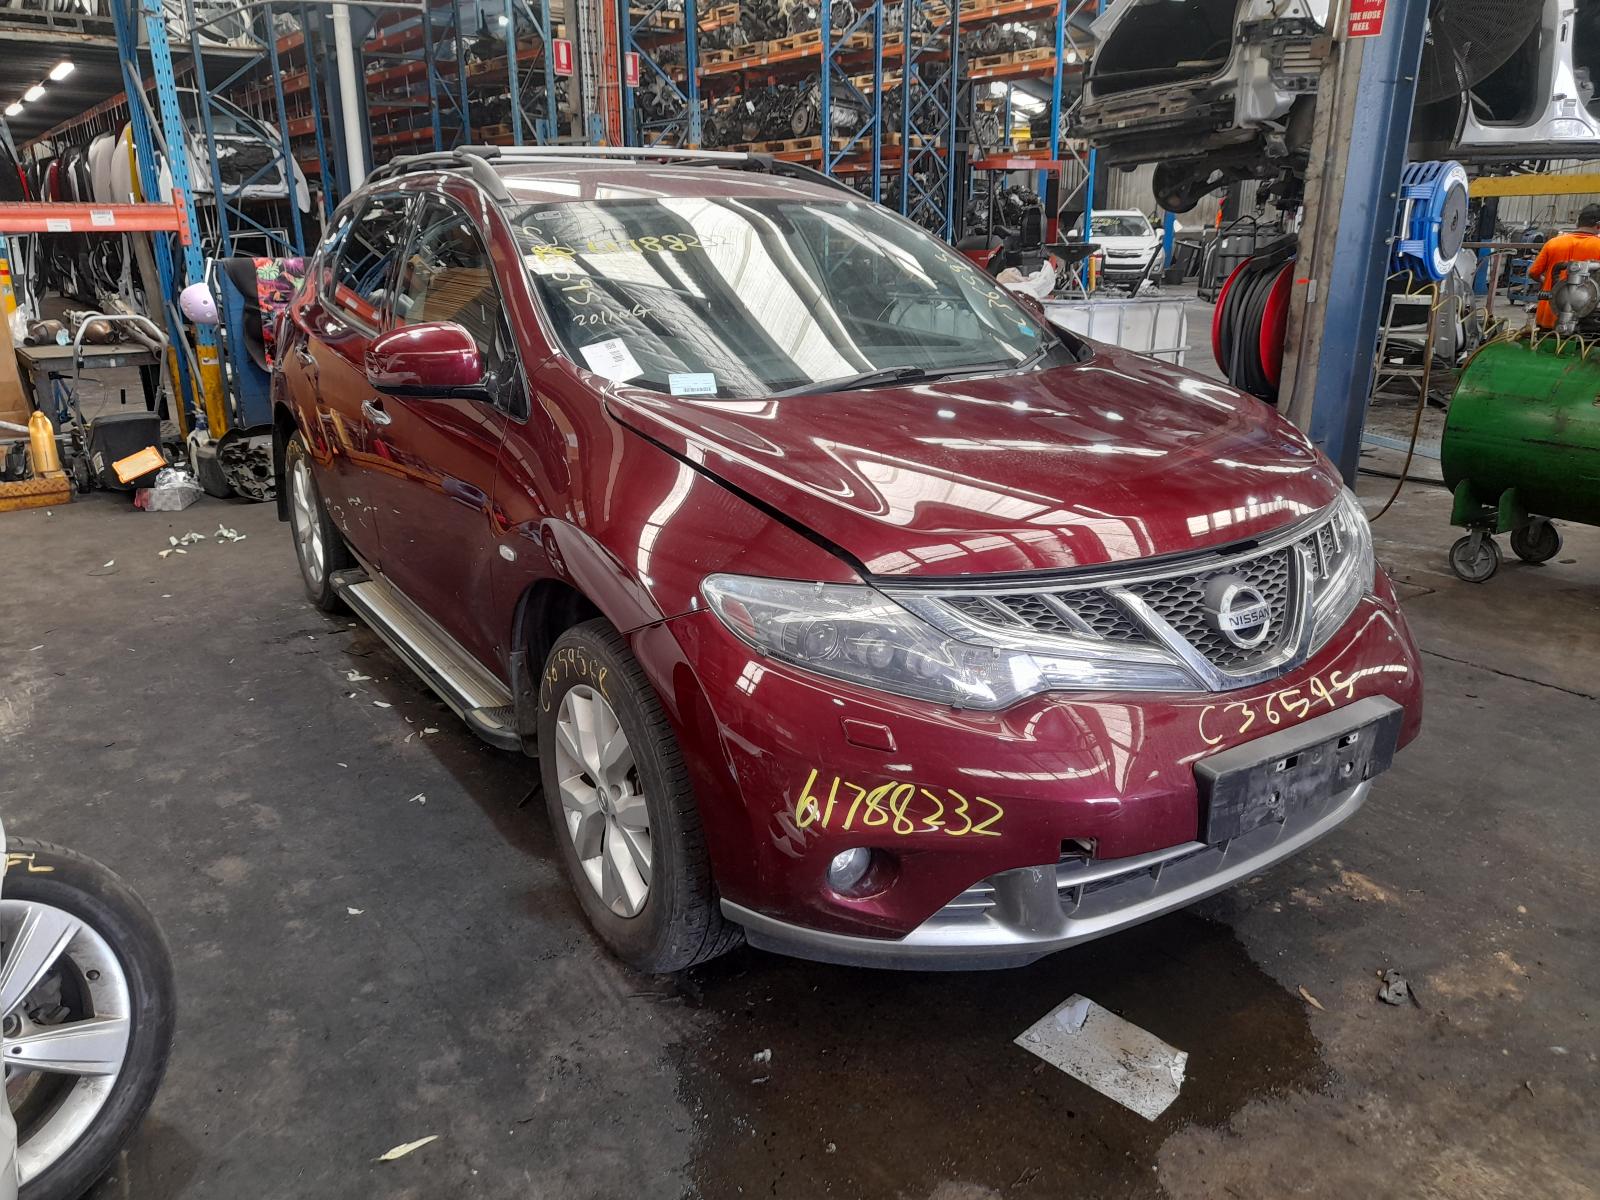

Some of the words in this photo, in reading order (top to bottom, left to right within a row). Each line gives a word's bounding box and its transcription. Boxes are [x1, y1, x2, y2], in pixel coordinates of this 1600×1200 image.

[1350, 12, 1361, 20] IRE
[1362, 10, 1381, 19] HOSE
[1352, 22, 1369, 31] REEL
[1228, 606, 1271, 627] NISSAN
[1199, 670, 1355, 745] C36595
[795, 768, 1005, 835] 61788232
